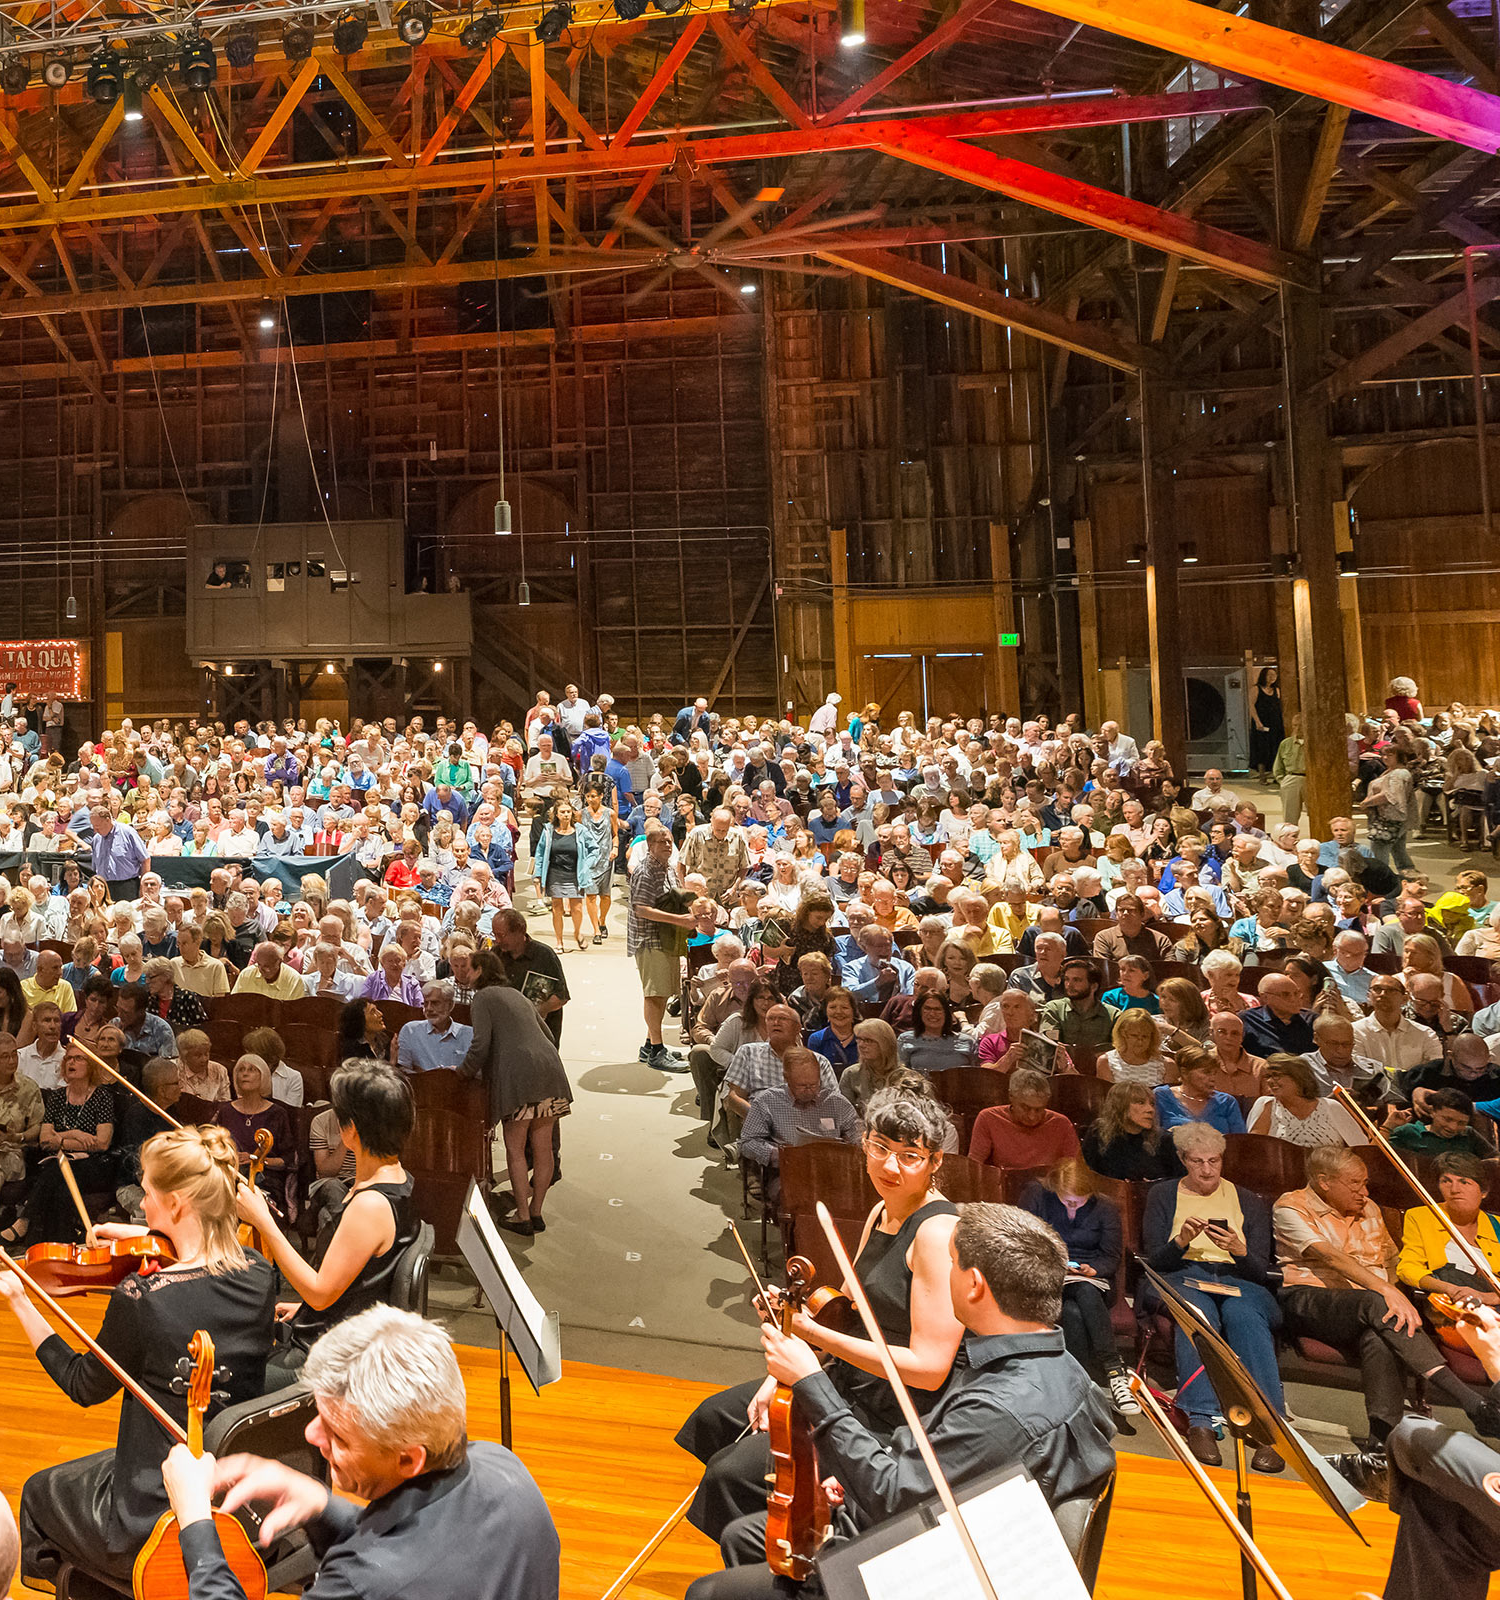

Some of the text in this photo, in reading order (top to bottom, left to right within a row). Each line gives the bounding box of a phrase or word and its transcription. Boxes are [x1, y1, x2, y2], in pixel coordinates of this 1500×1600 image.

[599, 1153, 614, 1161] D
[607, 1198, 624, 1207] C
[625, 1251, 642, 1262] B
[627, 1315, 646, 1328] A
